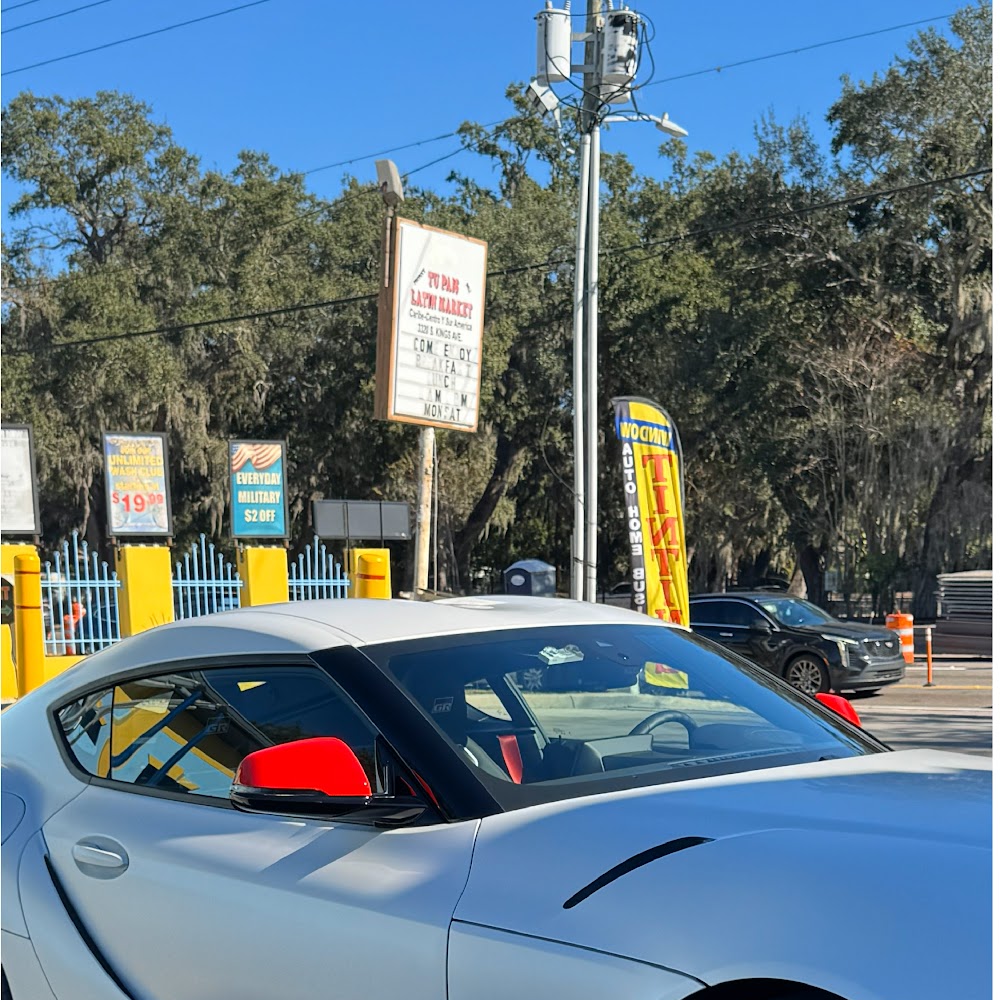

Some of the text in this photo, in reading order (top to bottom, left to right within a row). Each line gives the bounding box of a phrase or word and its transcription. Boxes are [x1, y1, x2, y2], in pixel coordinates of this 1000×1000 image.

[410, 288, 473, 319] LATIN MARKET
[110, 454, 164, 466] UNLIMITED
[111, 466, 137, 476] WASH
[236, 471, 280, 485] EVERYDAY
[238, 490, 281, 504] MILITARY
[244, 509, 276, 523] $2 OFF
